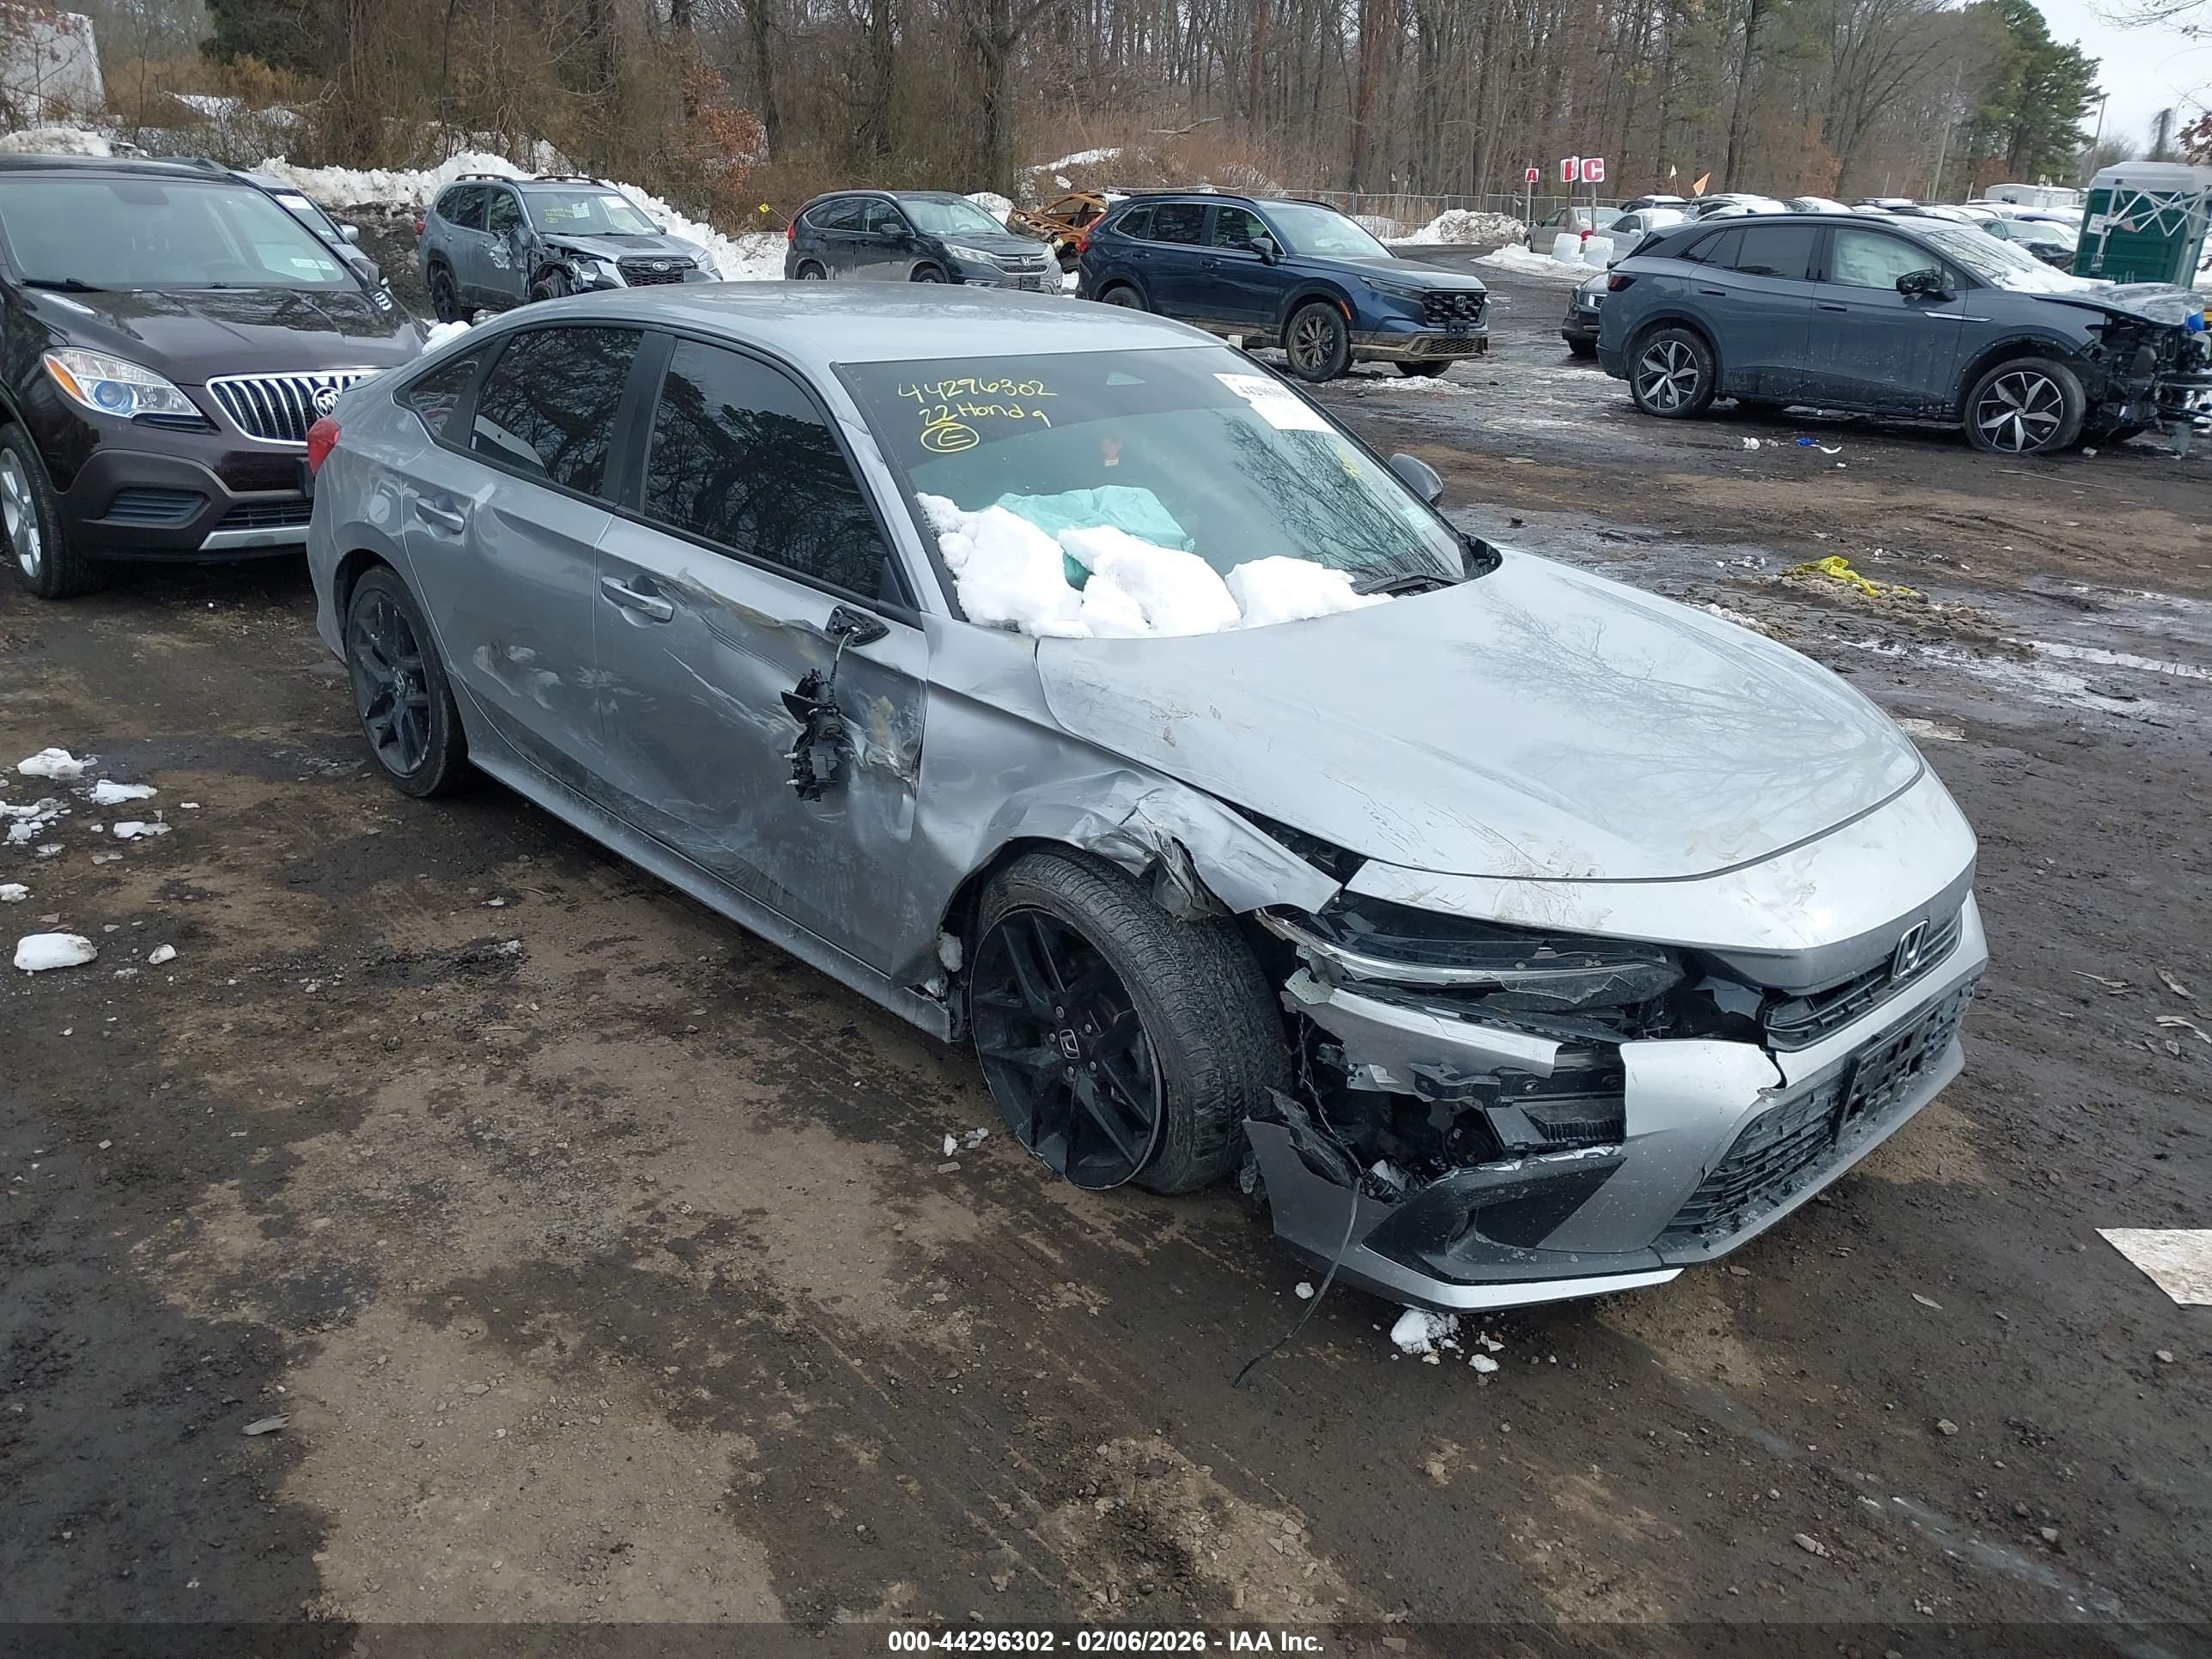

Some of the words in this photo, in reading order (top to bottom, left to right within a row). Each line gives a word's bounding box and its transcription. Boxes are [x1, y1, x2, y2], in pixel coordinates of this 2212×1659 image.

[1525, 169, 1538, 182] A
[1584, 160, 1603, 180] C
[897, 377, 1059, 404] 44296302
[918, 404, 958, 427] 22
